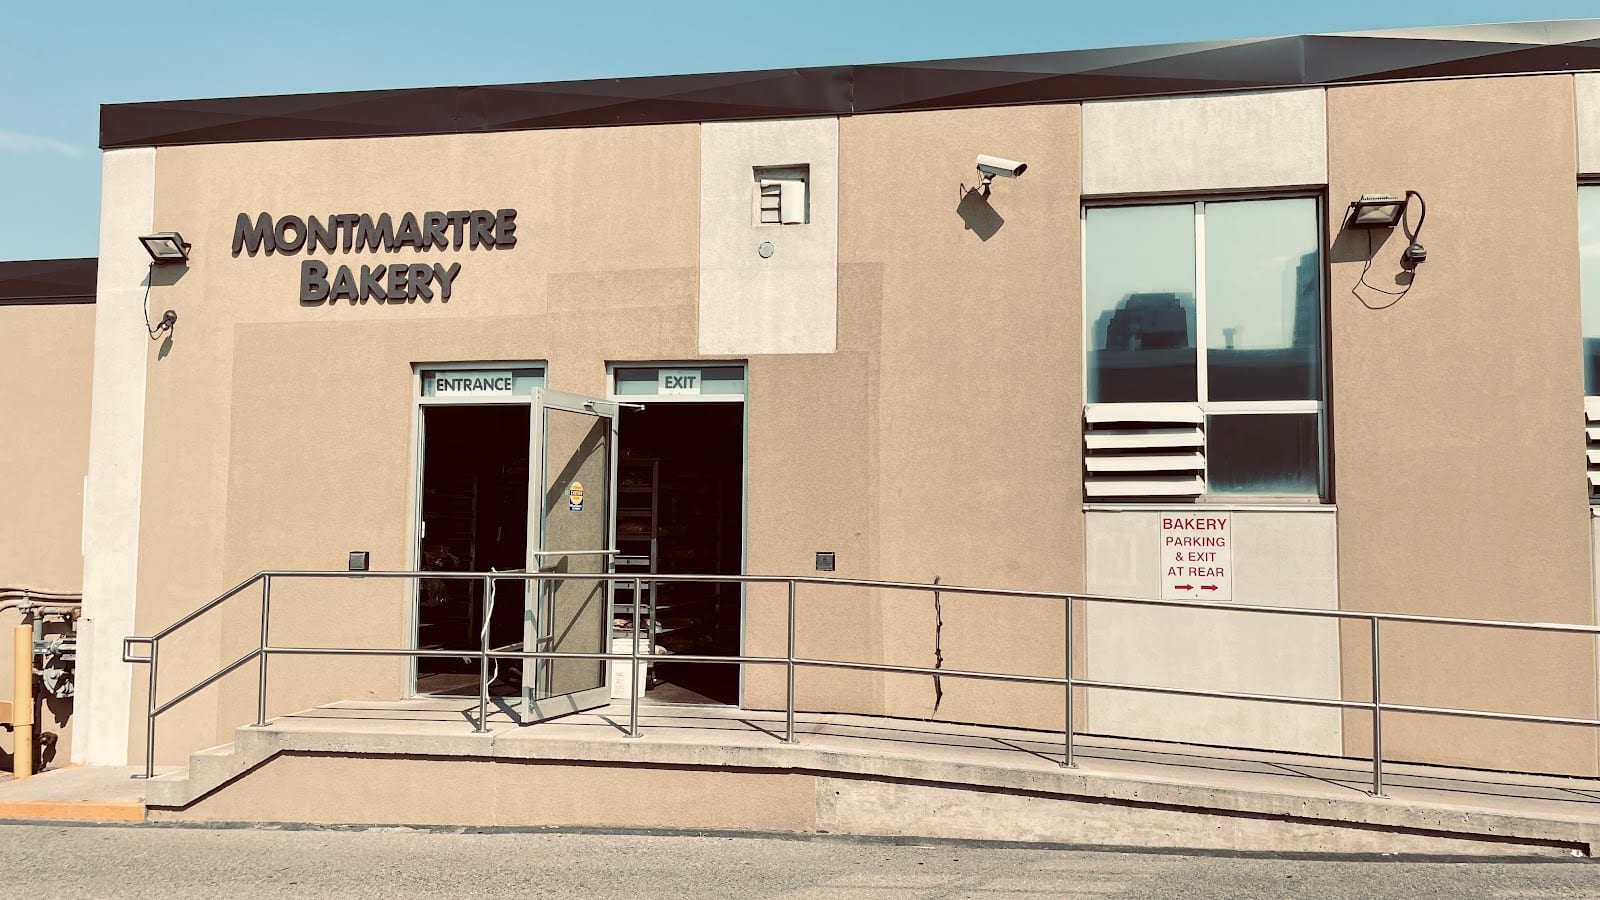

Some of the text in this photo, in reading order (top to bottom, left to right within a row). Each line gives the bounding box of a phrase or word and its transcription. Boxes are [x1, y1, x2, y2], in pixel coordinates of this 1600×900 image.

[232, 209, 517, 258] MONTMARTRE
[300, 260, 461, 307] BAKERY
[436, 377, 512, 391] ENTRANCE
[665, 375, 697, 389] EXIT
[1163, 518, 1227, 530] BAKERY
[1166, 536, 1225, 547] PARKING
[1175, 551, 1217, 562] & EXIT
[1168, 566, 1224, 577] AT REAR
